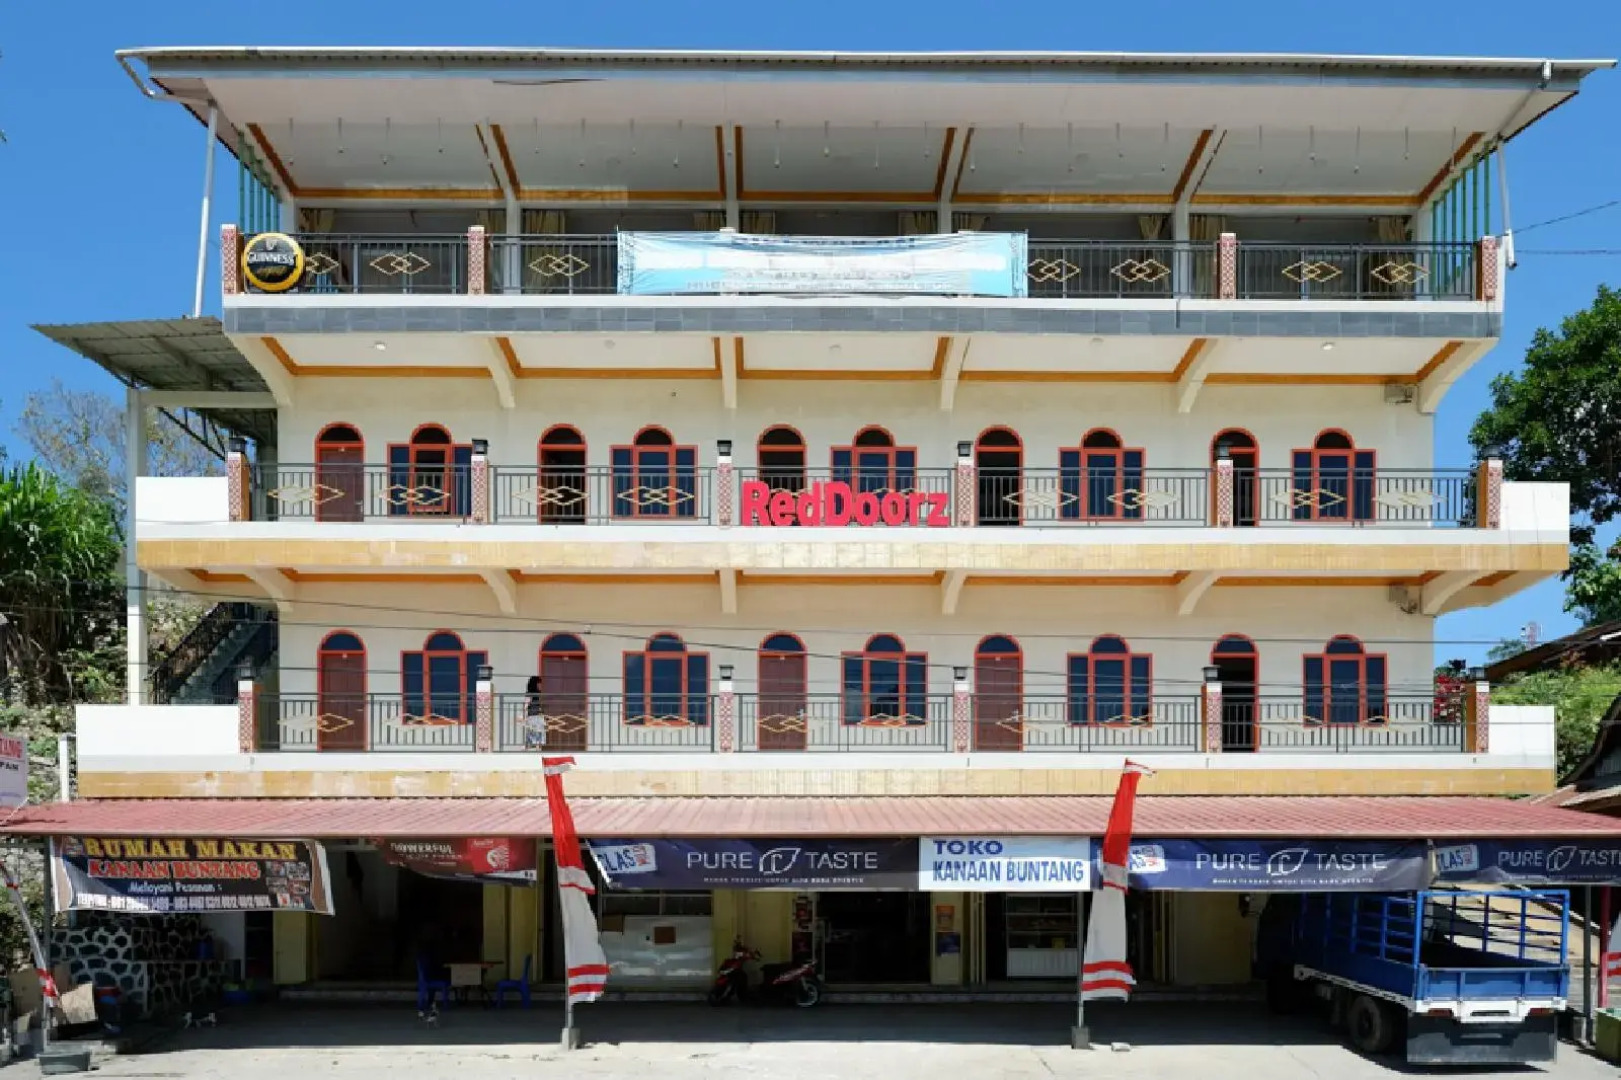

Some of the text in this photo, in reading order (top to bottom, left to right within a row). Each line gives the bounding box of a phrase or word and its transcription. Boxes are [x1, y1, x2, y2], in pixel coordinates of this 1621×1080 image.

[741, 480, 949, 526] RedDoorz
[85, 839, 297, 859] RUMAH MAKAN
[933, 840, 1004, 855] TOKO
[687, 851, 878, 870] PURE TASTE
[1196, 852, 1388, 871] PURE TASTE
[1498, 849, 1621, 867] PURE TAST
[88, 859, 261, 879] KANAAN BUNTANG
[933, 860, 1084, 882] KANAAN BUNTANG
